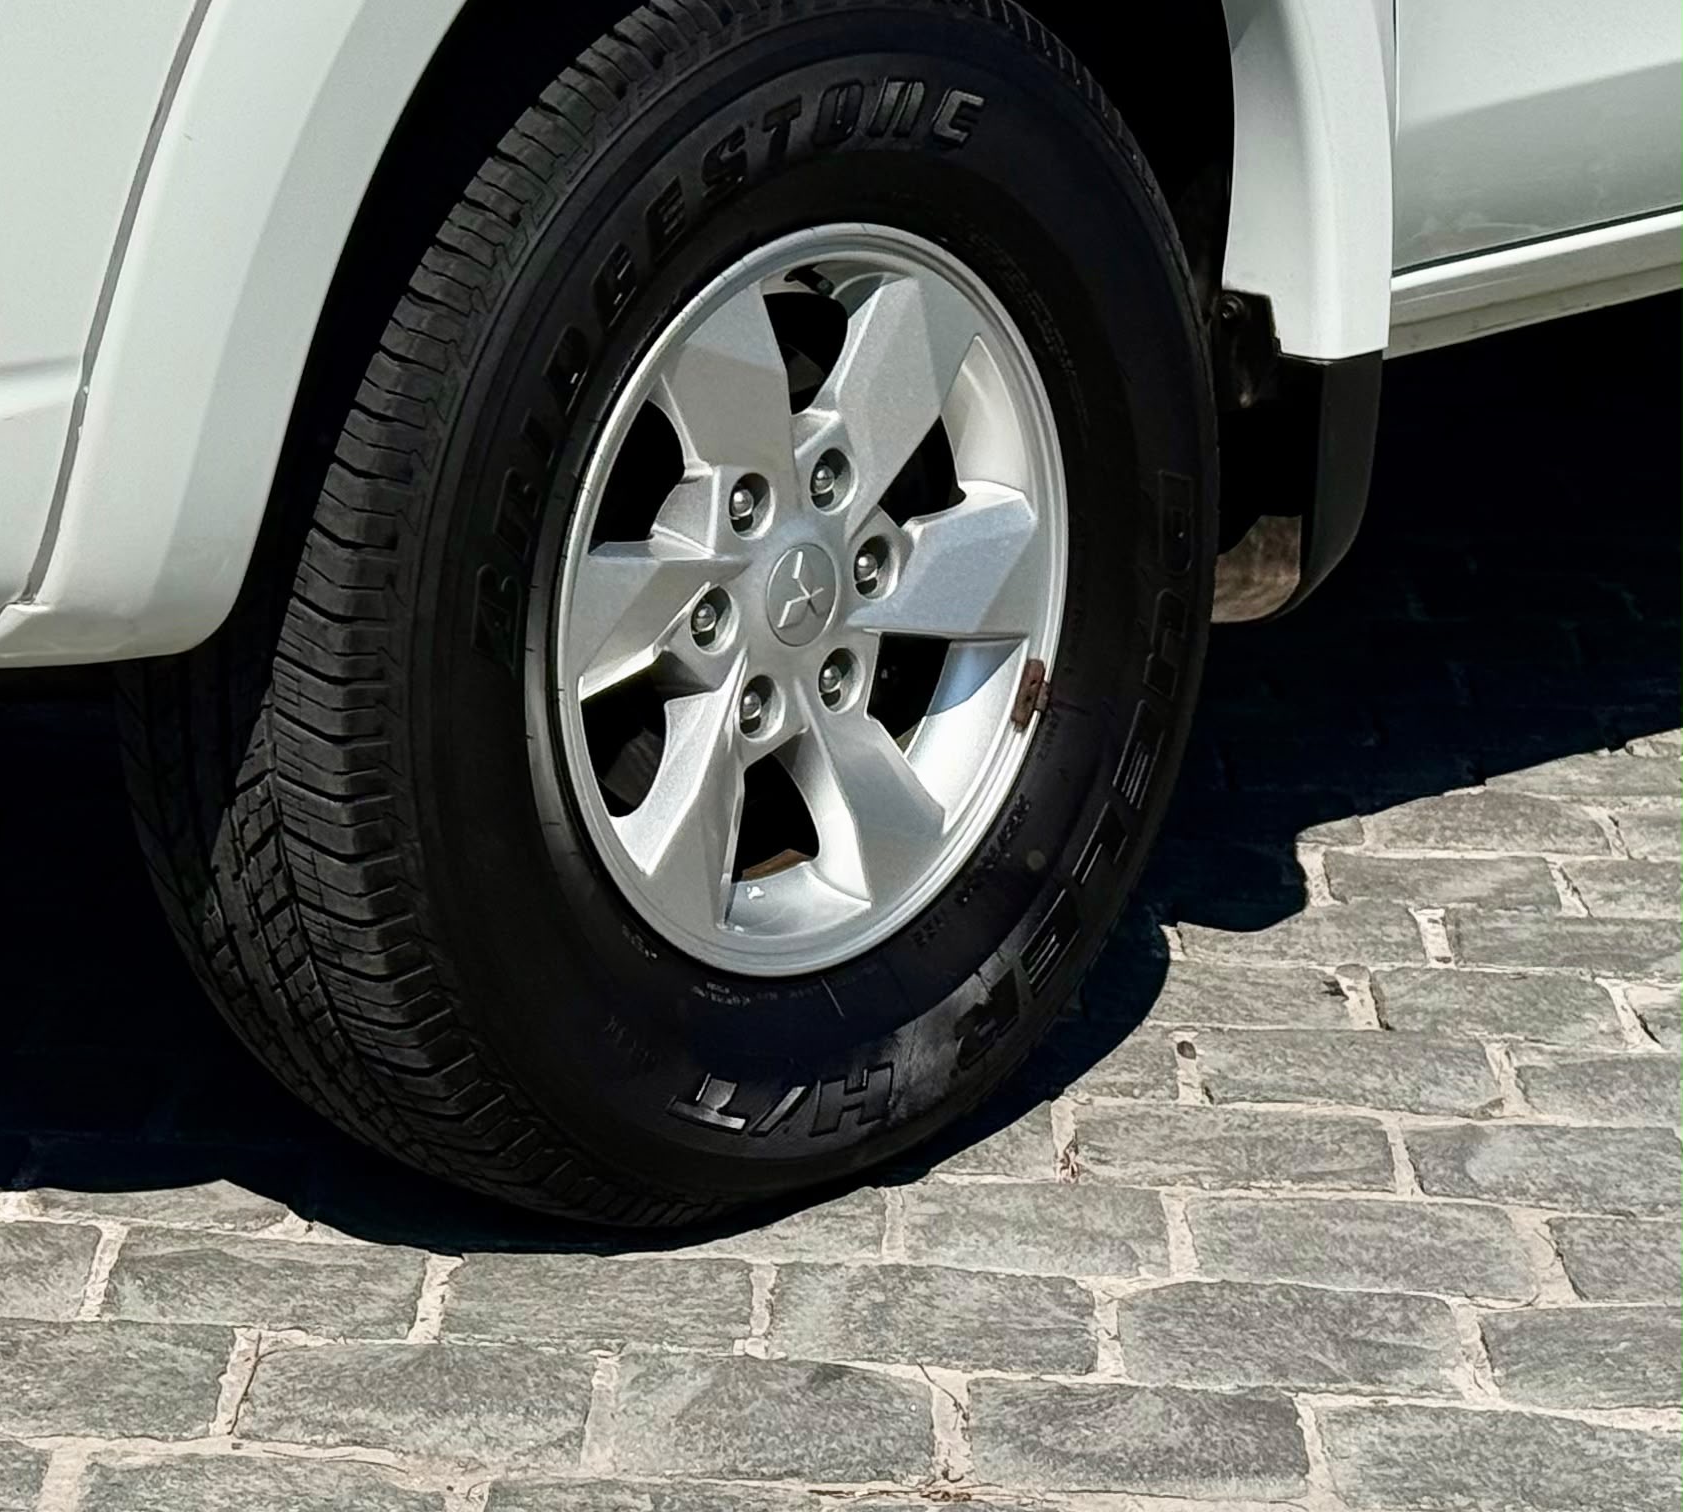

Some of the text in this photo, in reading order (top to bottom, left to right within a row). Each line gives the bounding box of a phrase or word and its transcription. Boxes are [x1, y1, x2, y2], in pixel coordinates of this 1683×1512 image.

[472, 76, 986, 676] BRIDGESTONE
[954, 470, 1194, 1068] DUELER
[667, 1061, 894, 1139] H/T
